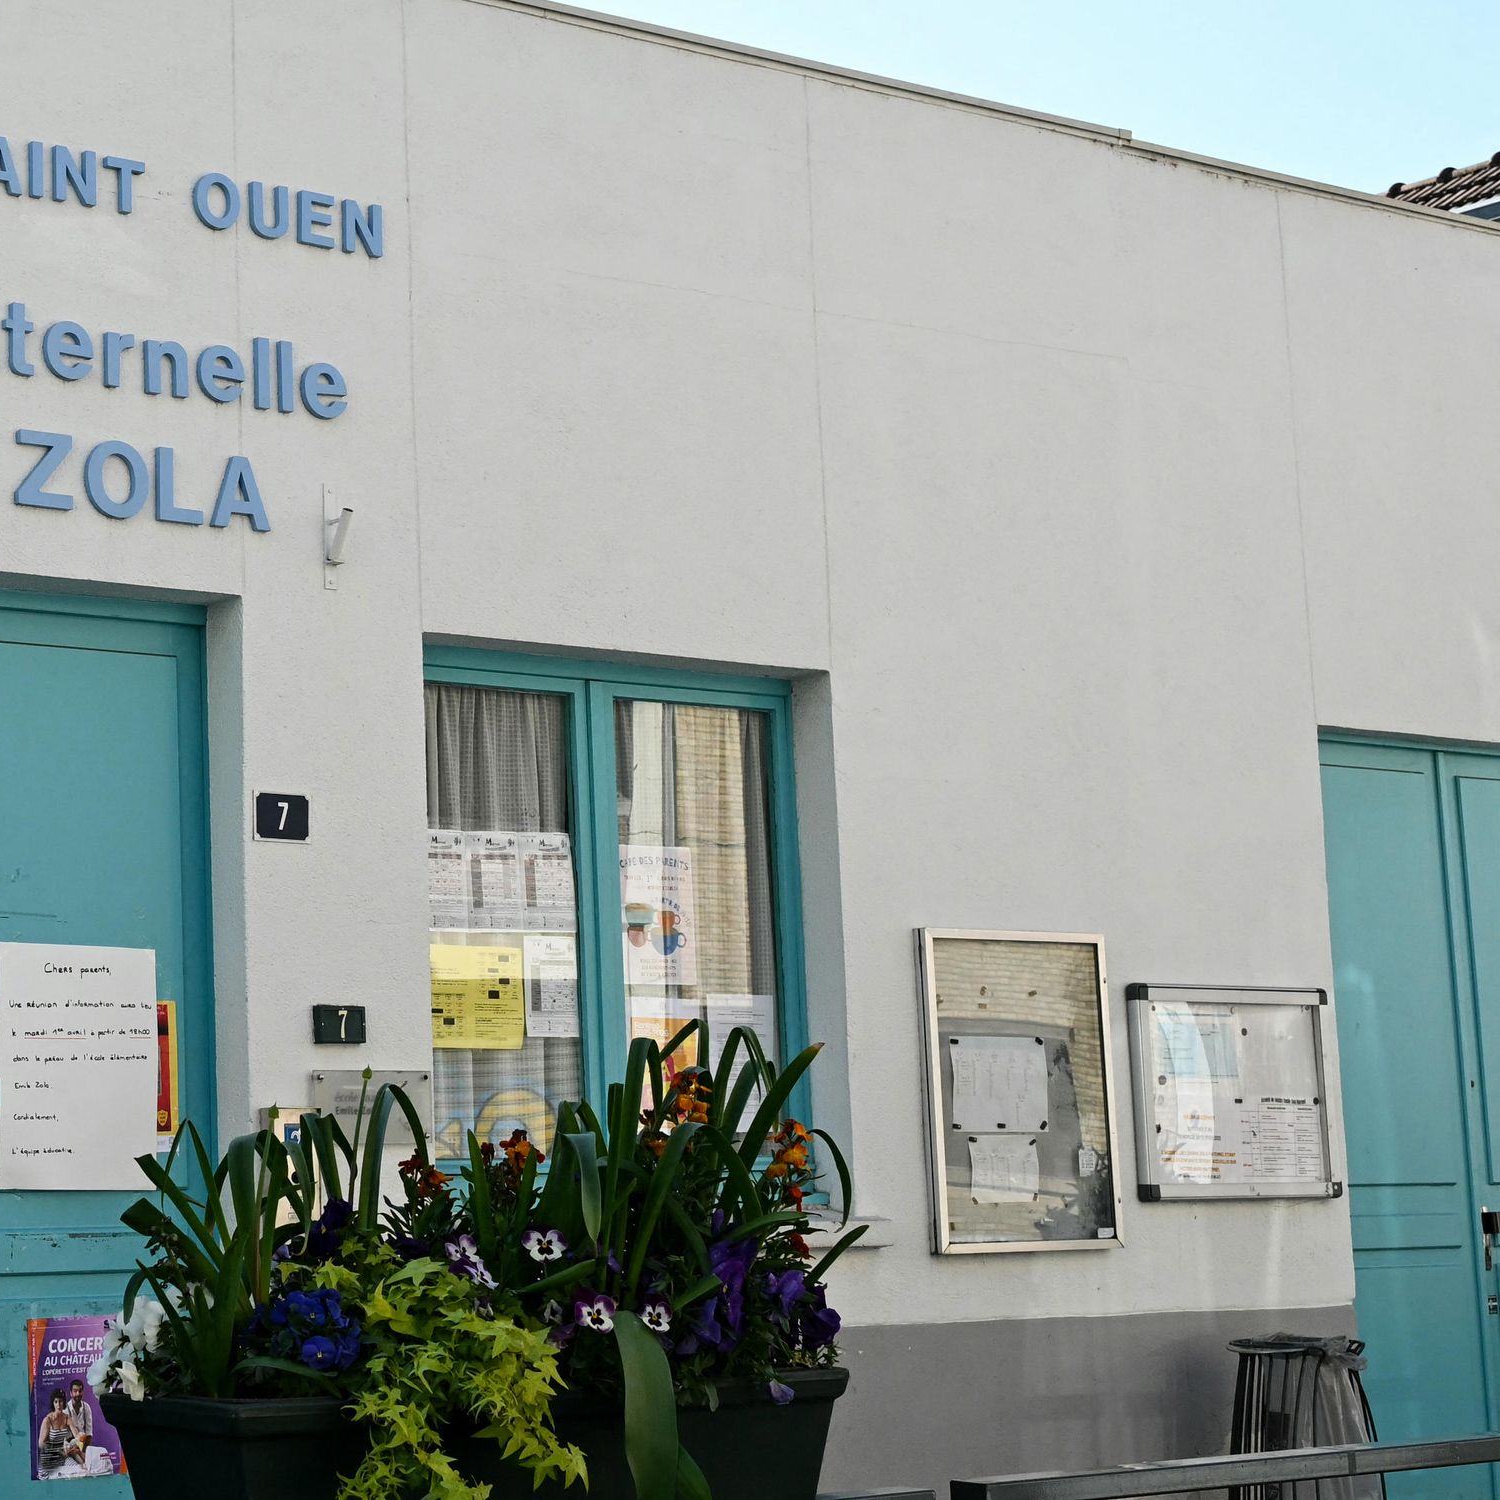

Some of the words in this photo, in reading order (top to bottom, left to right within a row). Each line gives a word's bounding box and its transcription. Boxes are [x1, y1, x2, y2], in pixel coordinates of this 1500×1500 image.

[192, 172, 384, 260] OUEN
[14, 427, 271, 534] ZOLA
[277, 801, 290, 831] 7
[44, 962, 73, 974] Chers
[80, 964, 111, 979] parents,
[8, 999, 22, 1008] Une
[65, 999, 114, 1008] d'information
[337, 1009, 349, 1039] 7
[24, 1028, 48, 1036] mardi
[97, 1029, 115, 1039] partir
[118, 1028, 126, 1036] de
[48, 1336, 104, 1354] CONCER
[44, 1356, 57, 1367] AU
